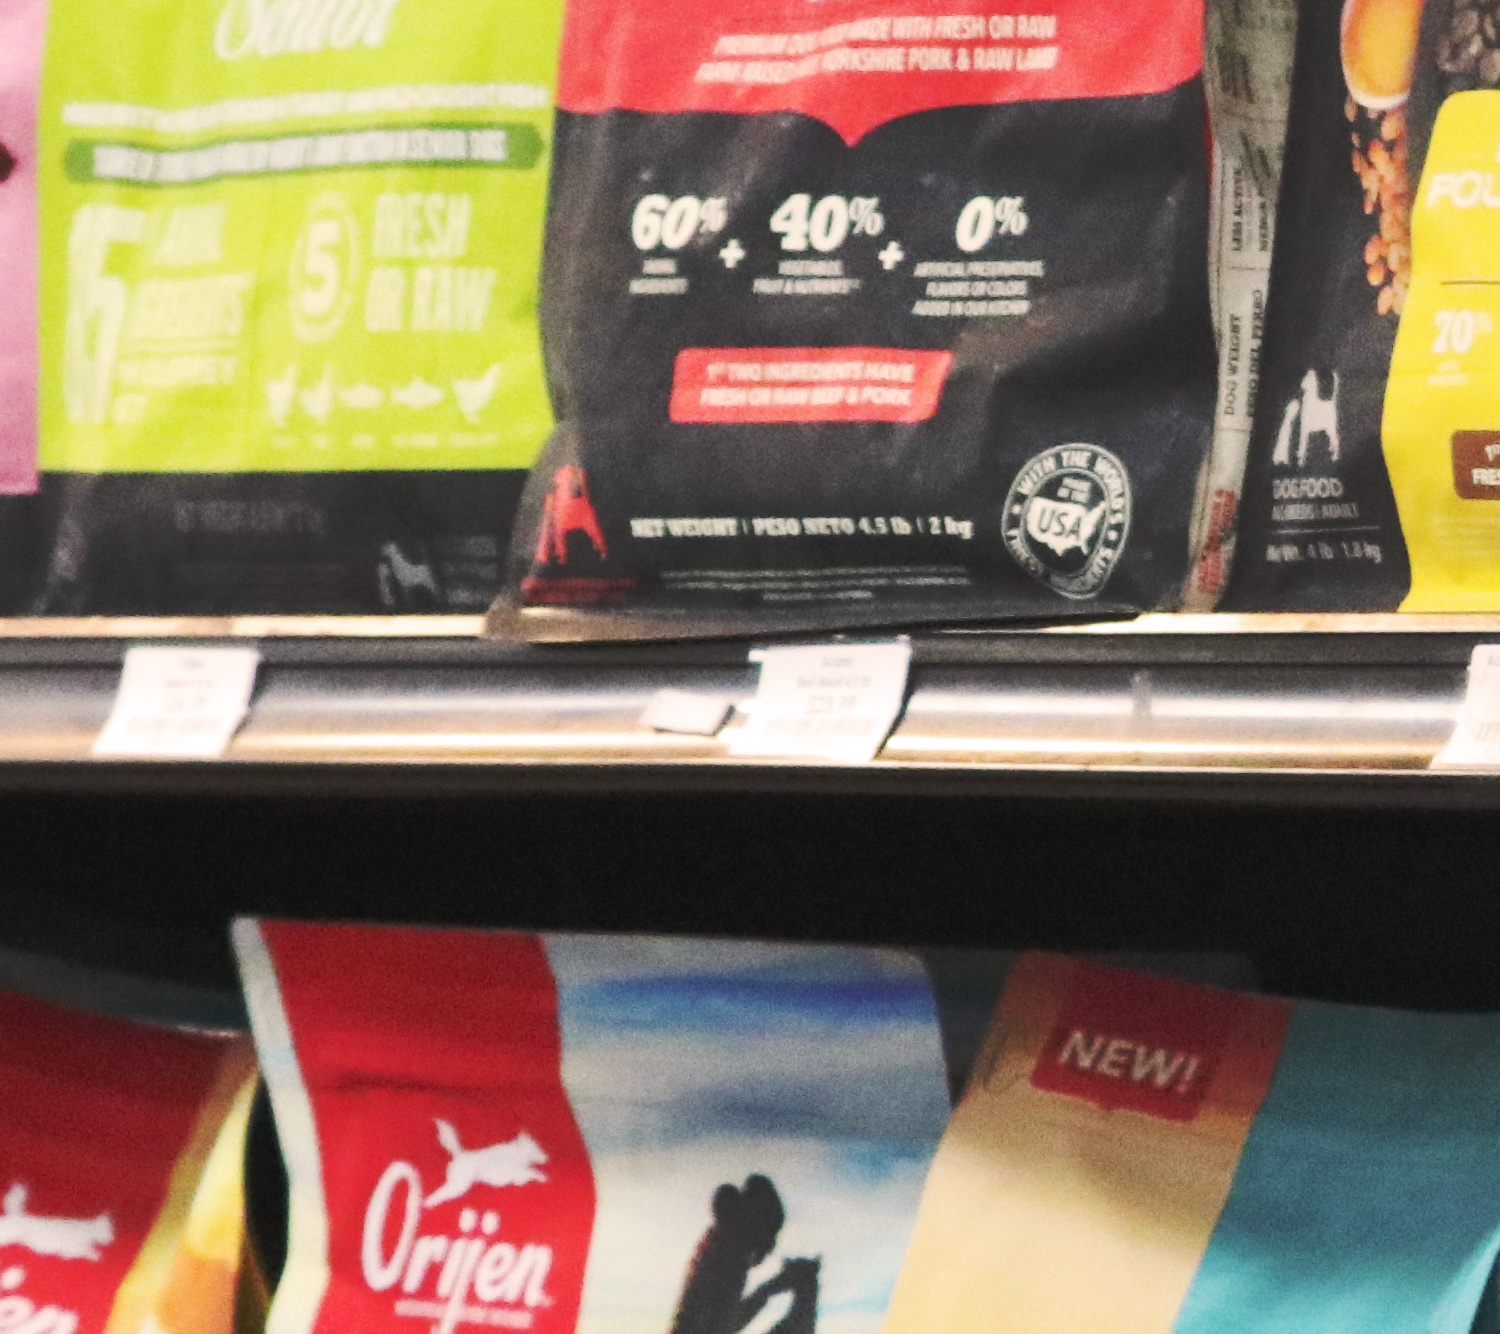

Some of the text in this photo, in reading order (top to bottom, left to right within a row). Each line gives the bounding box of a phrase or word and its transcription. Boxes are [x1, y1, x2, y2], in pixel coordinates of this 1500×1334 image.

[631, 193, 1029, 253] 60% 40% 0%
[1060, 1032, 1201, 1093] NEW!
